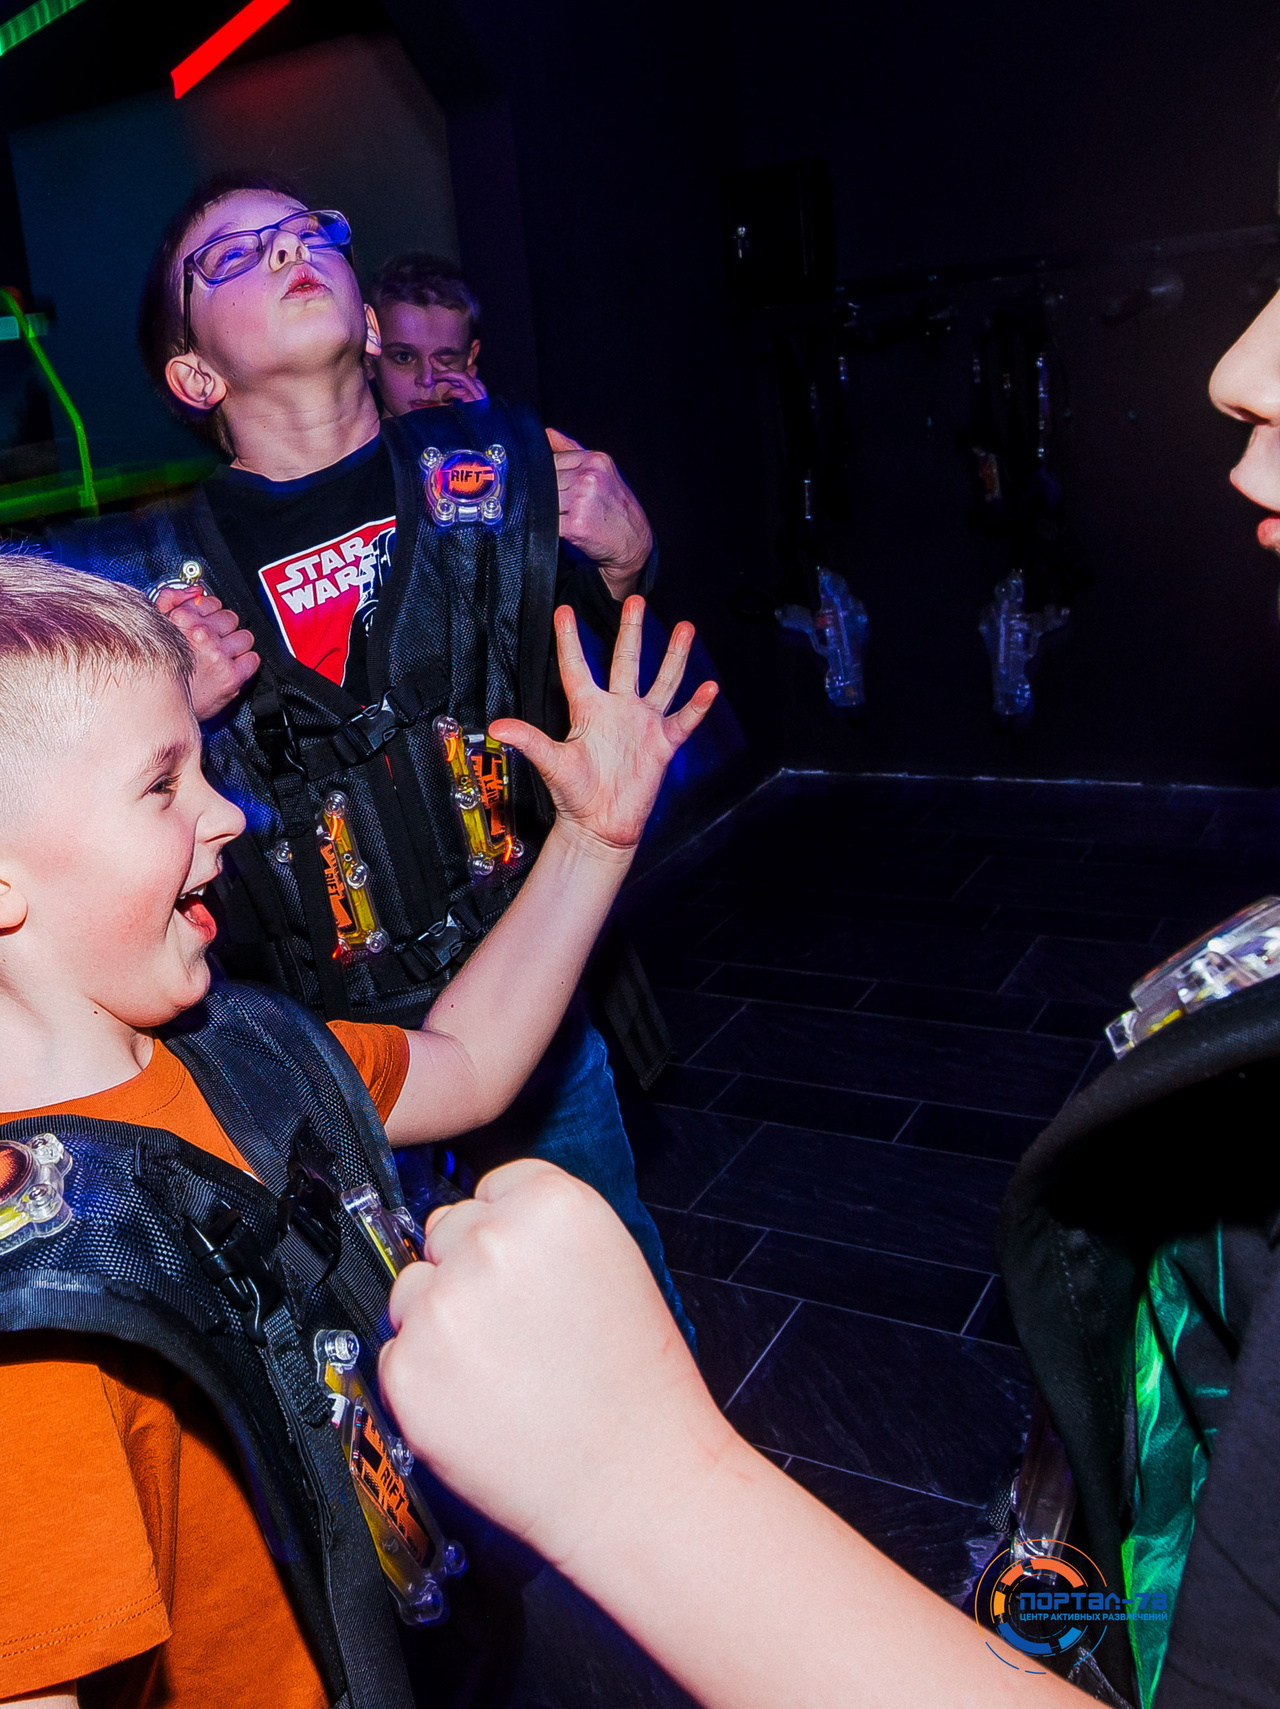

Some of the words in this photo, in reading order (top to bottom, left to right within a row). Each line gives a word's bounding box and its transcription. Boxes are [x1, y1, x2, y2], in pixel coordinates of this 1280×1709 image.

[451, 470, 482, 482] RIFT
[276, 537, 375, 593] STAR
[281, 553, 376, 614] WARS
[325, 873, 340, 896] RIFT
[380, 1466, 406, 1511] RIFT
